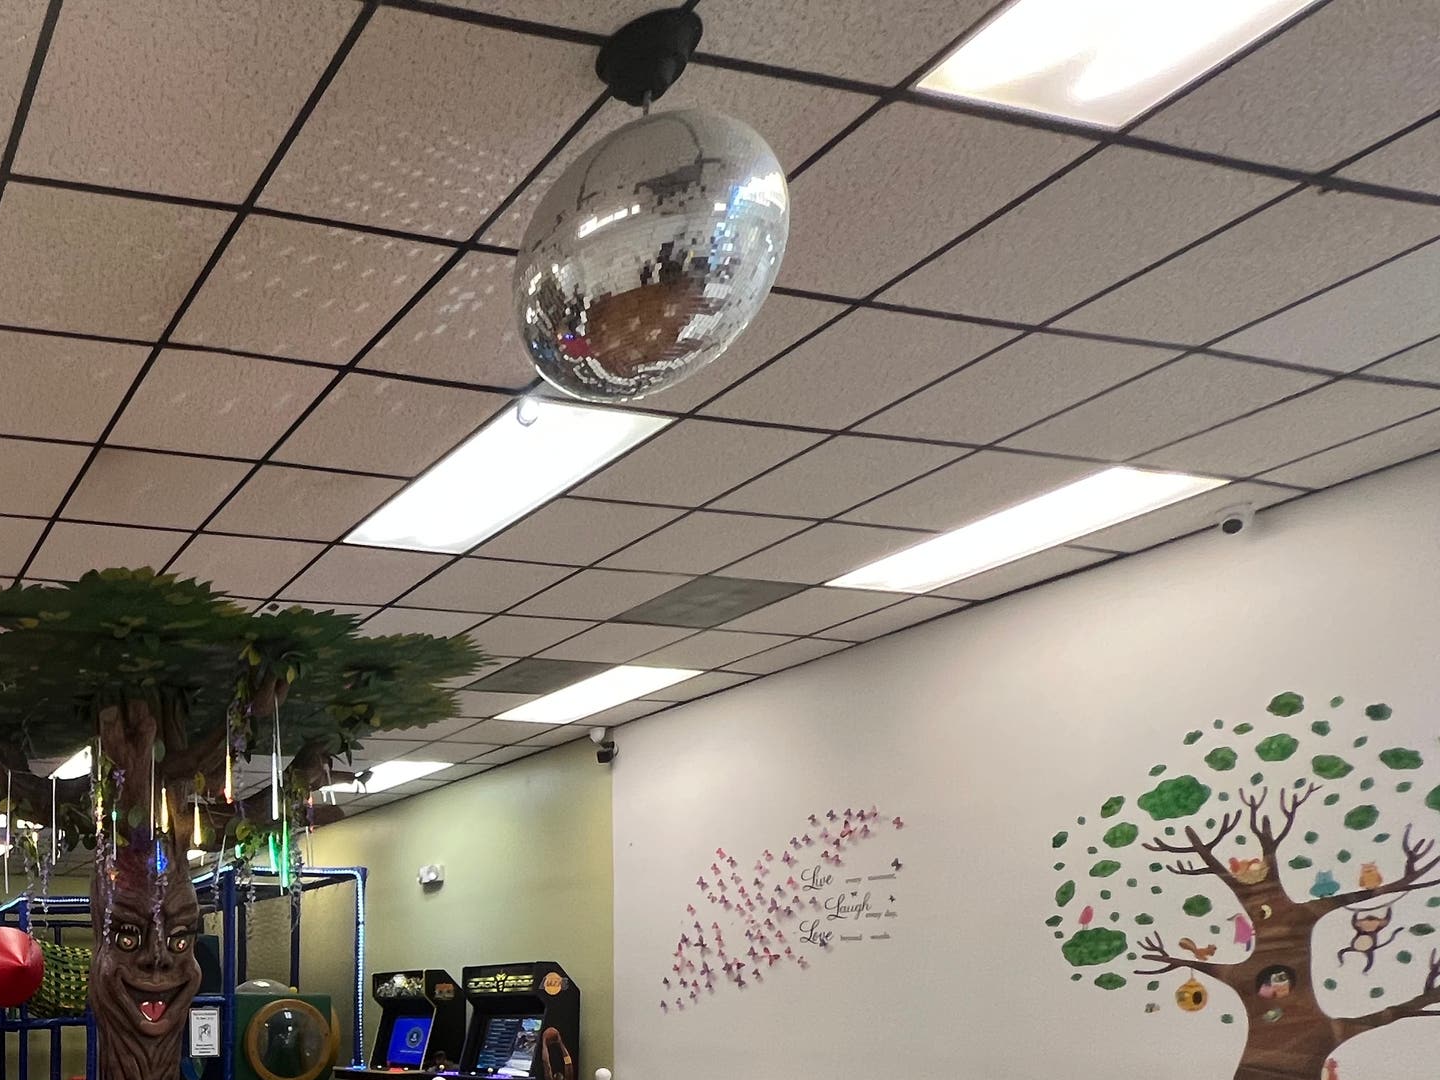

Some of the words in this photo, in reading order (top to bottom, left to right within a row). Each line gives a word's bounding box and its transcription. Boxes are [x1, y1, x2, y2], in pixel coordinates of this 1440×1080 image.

[801, 865, 833, 891] Live
[824, 892, 872, 920] Laugh
[799, 919, 834, 944] Love
